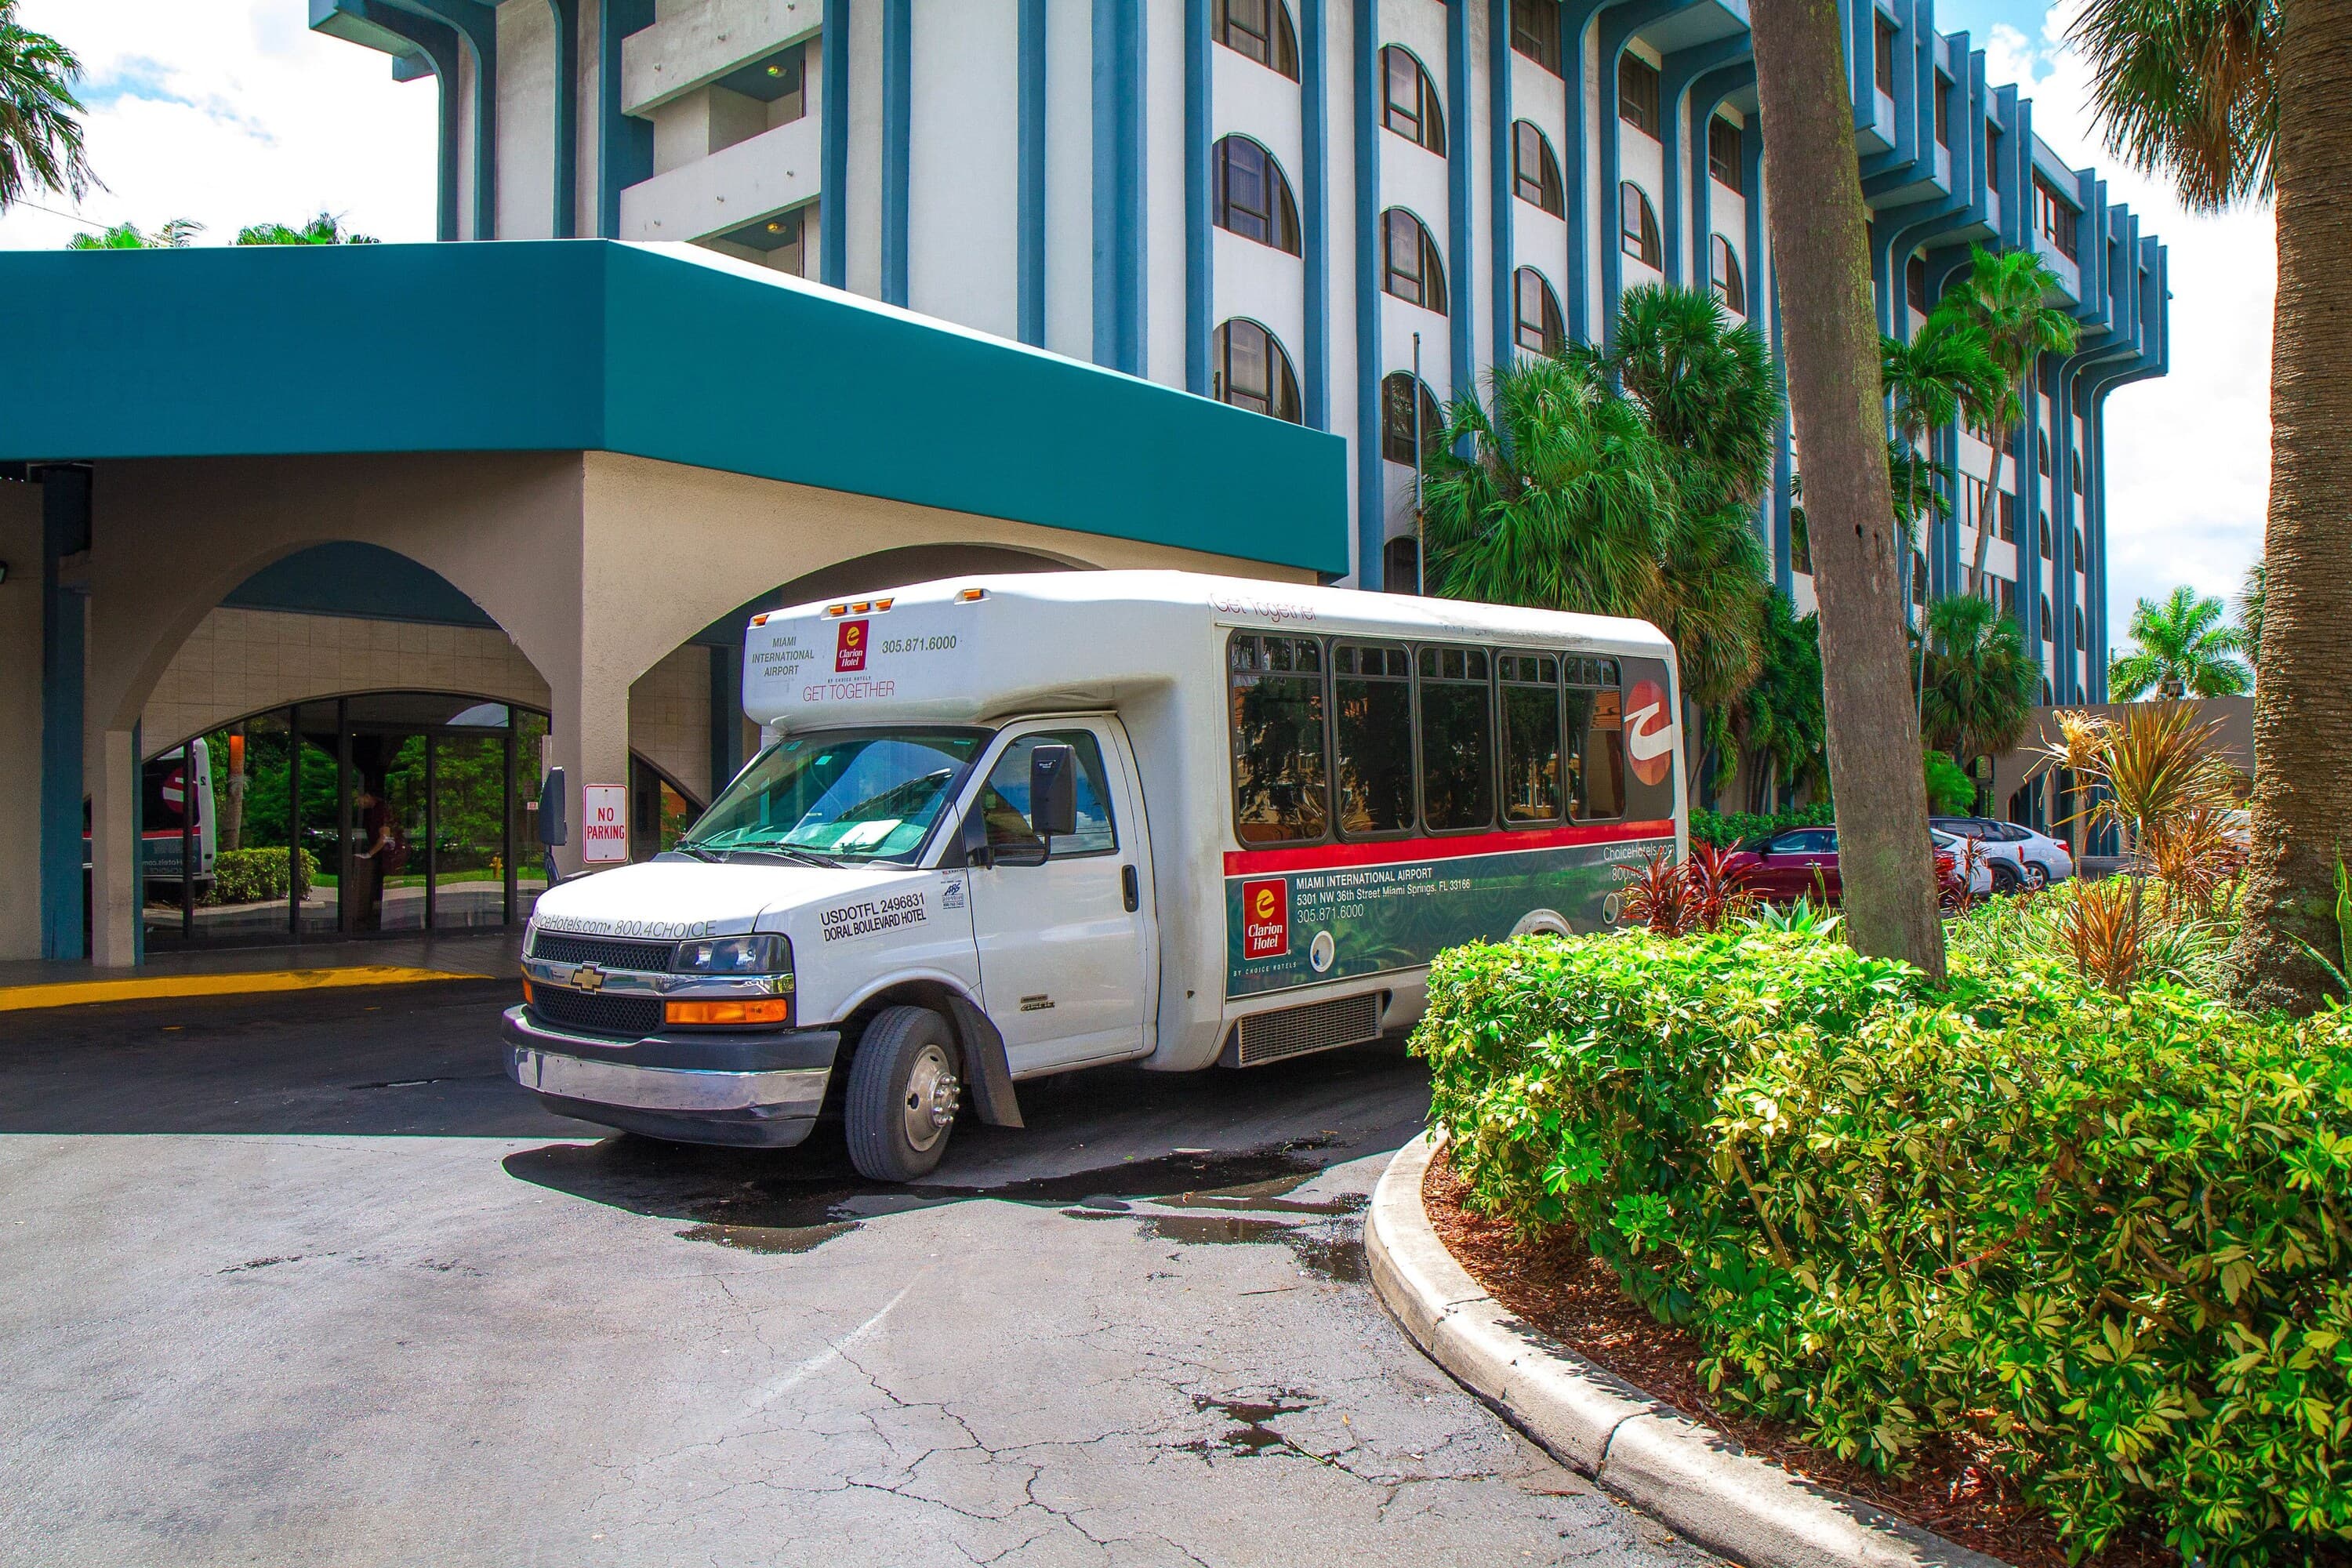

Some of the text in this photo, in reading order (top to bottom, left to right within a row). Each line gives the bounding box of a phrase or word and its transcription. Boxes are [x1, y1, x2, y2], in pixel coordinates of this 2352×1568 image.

[773, 637, 797, 648] MIAMI
[882, 636, 956, 653] 305.871.6000
[752, 649, 814, 663] INTERNATIONAL
[839, 648, 862, 659] Clarion
[842, 657, 859, 666] Hotel
[764, 666, 799, 677] AIRPORT
[803, 681, 895, 702] GET TOGETHER
[598, 808, 614, 821] NO
[588, 825, 625, 839] PARKING
[1296, 868, 1432, 890] MIAMI INTERNATIONAL AIRPORT
[1297, 894, 1318, 906] 5301
[1319, 892, 1334, 904] NW
[1337, 891, 1354, 902] 36th
[1356, 888, 1380, 899] Street
[1382, 886, 1405, 898] Miami
[1439, 881, 1448, 891] FL
[1450, 879, 1470, 890] 33166
[821, 893, 924, 926] USDOTFL 2496831
[1297, 904, 1364, 924] 305.871.6000
[614, 920, 717, 938] 800.4CHOICE
[824, 909, 926, 942] DORAL BOULEVARD HOTEL
[1248, 922, 1283, 937] Clarion
[1254, 935, 1278, 950] Hotel
[1245, 965, 1269, 975] CHOICE
[1273, 962, 1297, 971] HOTELS
